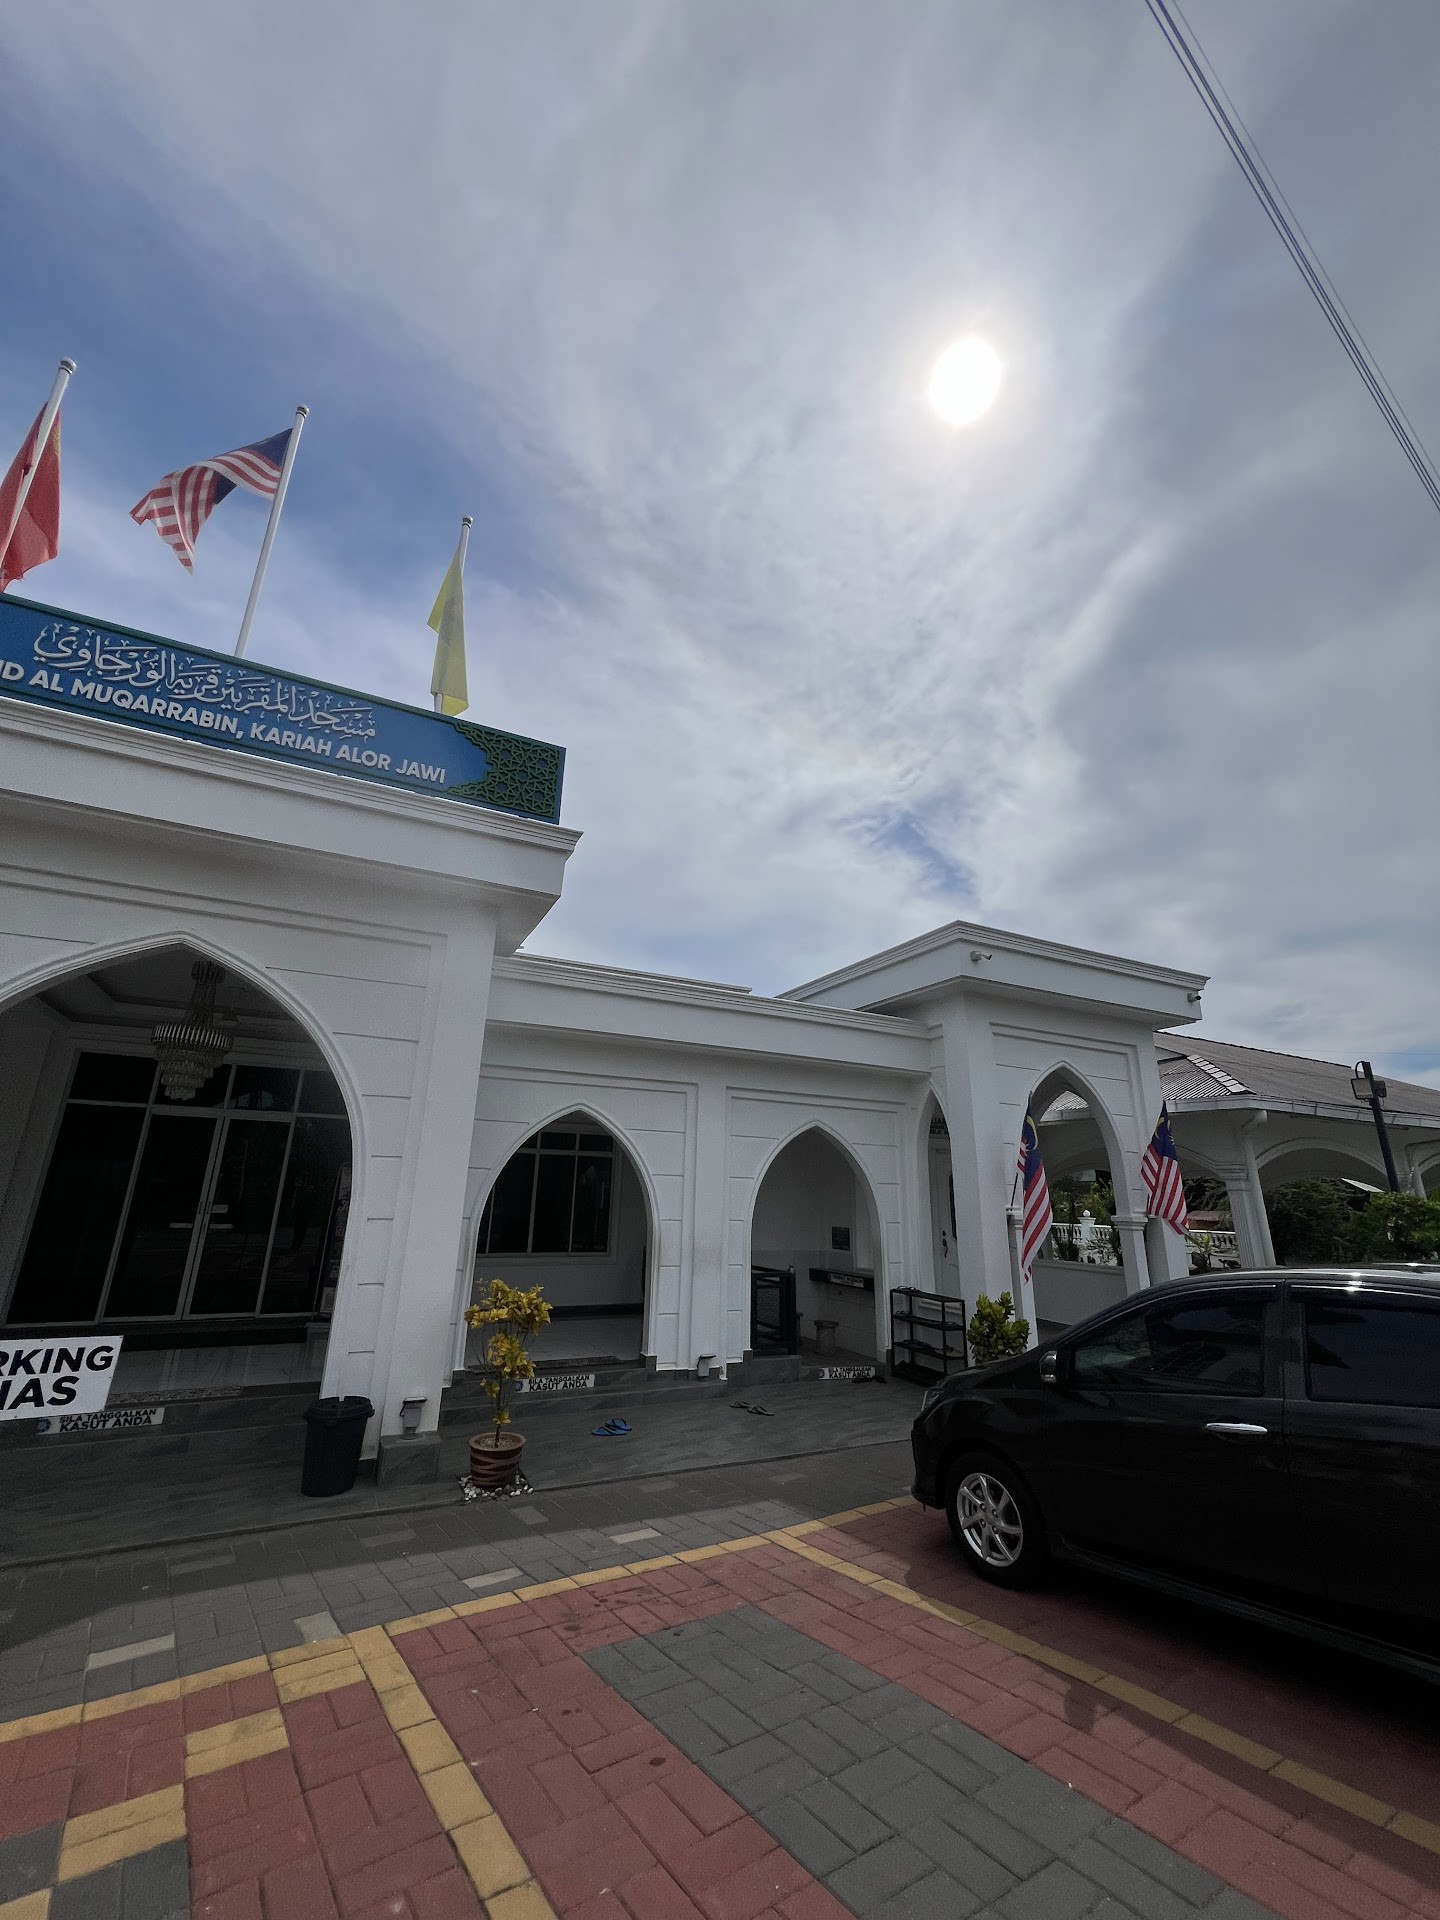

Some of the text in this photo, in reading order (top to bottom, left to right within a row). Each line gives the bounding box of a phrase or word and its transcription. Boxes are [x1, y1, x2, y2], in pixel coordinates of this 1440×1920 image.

[29, 669, 64, 694] AL
[71, 678, 244, 739] MUQARRABIN,
[250, 722, 332, 757] KARIAH
[335, 744, 391, 771] ALOR
[395, 759, 446, 784] JAWI
[529, 1380, 588, 1391] KASUT ANDA
[60, 1408, 157, 1423] SILA TANGGALKAN
[60, 1415, 152, 1432] KASUT ANDA
